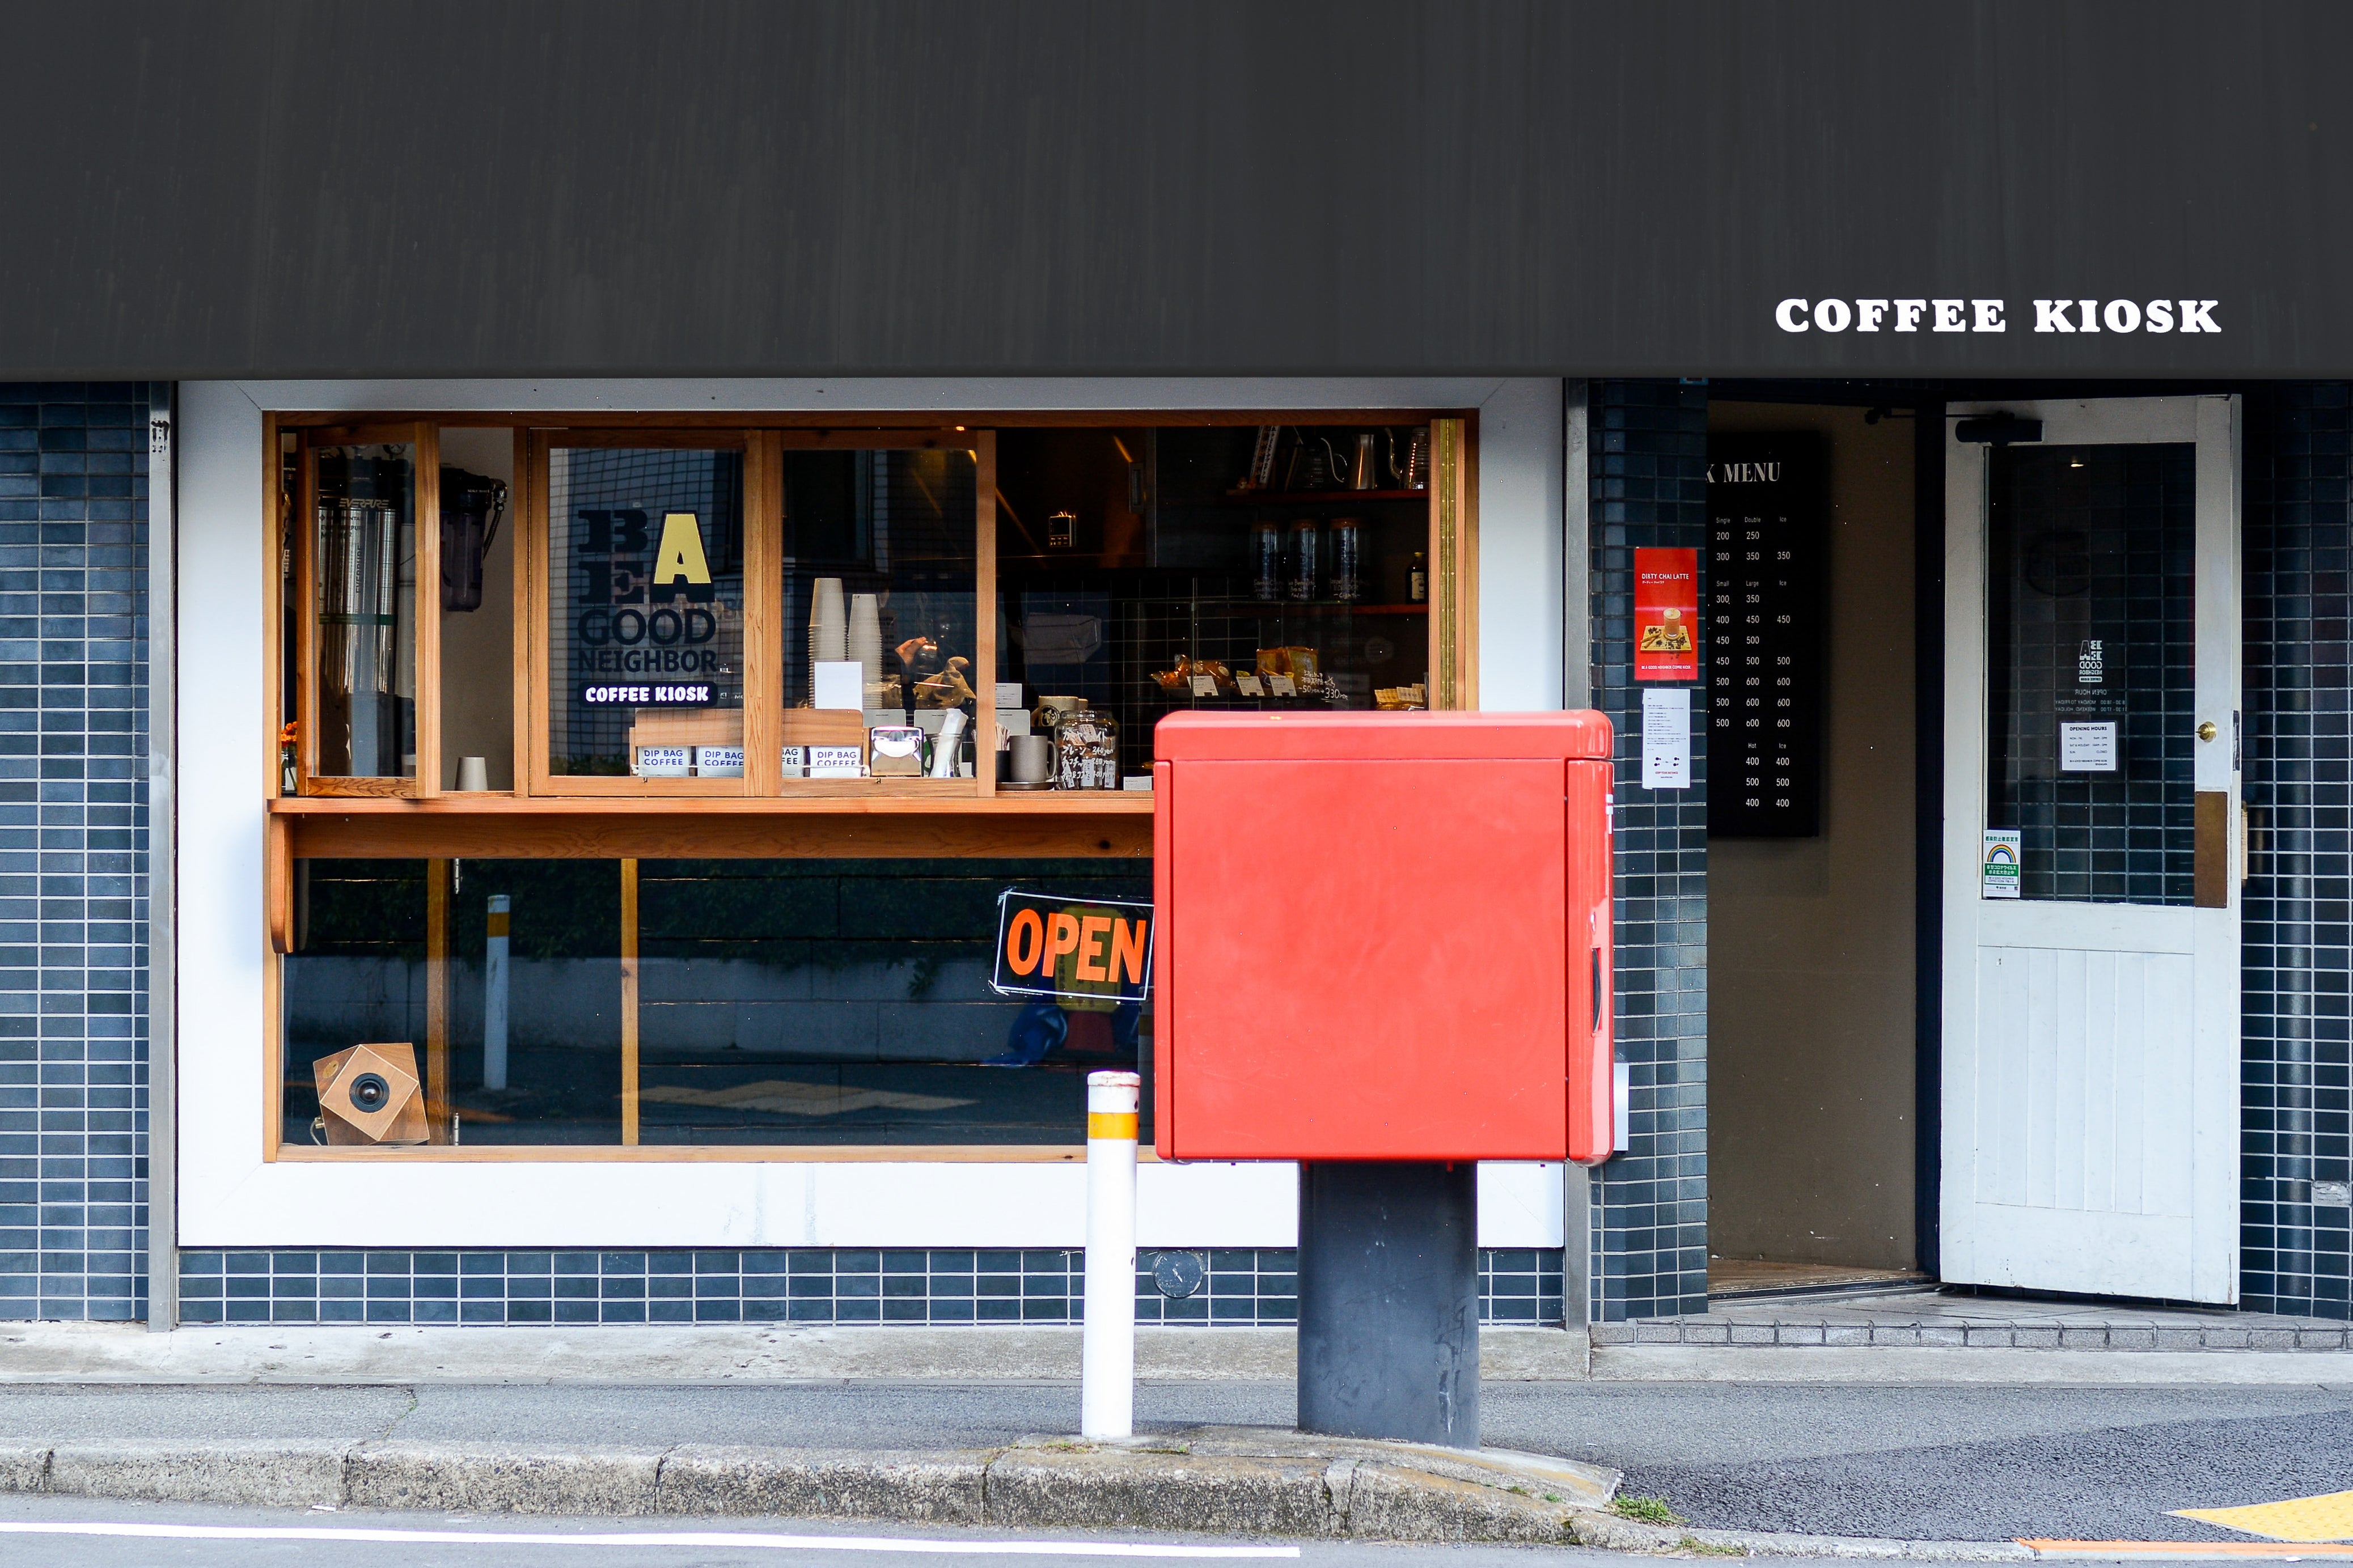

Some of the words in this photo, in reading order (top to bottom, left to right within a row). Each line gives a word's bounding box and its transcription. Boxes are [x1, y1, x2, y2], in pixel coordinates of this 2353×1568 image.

[1776, 298, 2006, 333] COFFEE
[2033, 299, 2221, 333] KIOSK
[1723, 462, 1780, 482] MENU
[339, 498, 390, 508] EVERPURE
[1716, 532, 1729, 540] 200
[1746, 531, 1759, 540] 250
[649, 510, 715, 603] A
[1716, 552, 1729, 561] 300
[1746, 552, 1759, 560] 350
[1777, 551, 1791, 560] 350
[1716, 595, 1729, 603] 300
[1746, 595, 1759, 603] 350
[1716, 616, 1729, 624] 400
[1746, 615, 1759, 624] 450
[1777, 615, 1791, 624] 450
[578, 609, 716, 646] GOOD
[1716, 636, 1729, 645] 450
[1746, 636, 1759, 645] 500
[578, 650, 717, 673] NEIGHBOR
[1746, 656, 1759, 665] 500
[1777, 656, 1791, 665] 500
[1716, 677, 1729, 686] 500
[1746, 677, 1759, 686] 600
[1777, 677, 1791, 686] 600
[586, 687, 650, 702] COFFEE
[655, 686, 709, 701] KIOSK
[1716, 698, 1729, 706] 500
[1746, 698, 1759, 706] 600
[1777, 698, 1791, 707] 600
[1716, 719, 1729, 727] 500
[1746, 719, 1759, 727] 600
[1777, 719, 1791, 727] 600
[1745, 757, 1759, 766] 400
[1776, 757, 1789, 766] 400
[1746, 778, 1759, 786] 500
[1776, 778, 1789, 787] 500
[1745, 798, 1759, 807] 400
[1776, 799, 1789, 807] 400
[1007, 909, 1147, 984] OPEN
